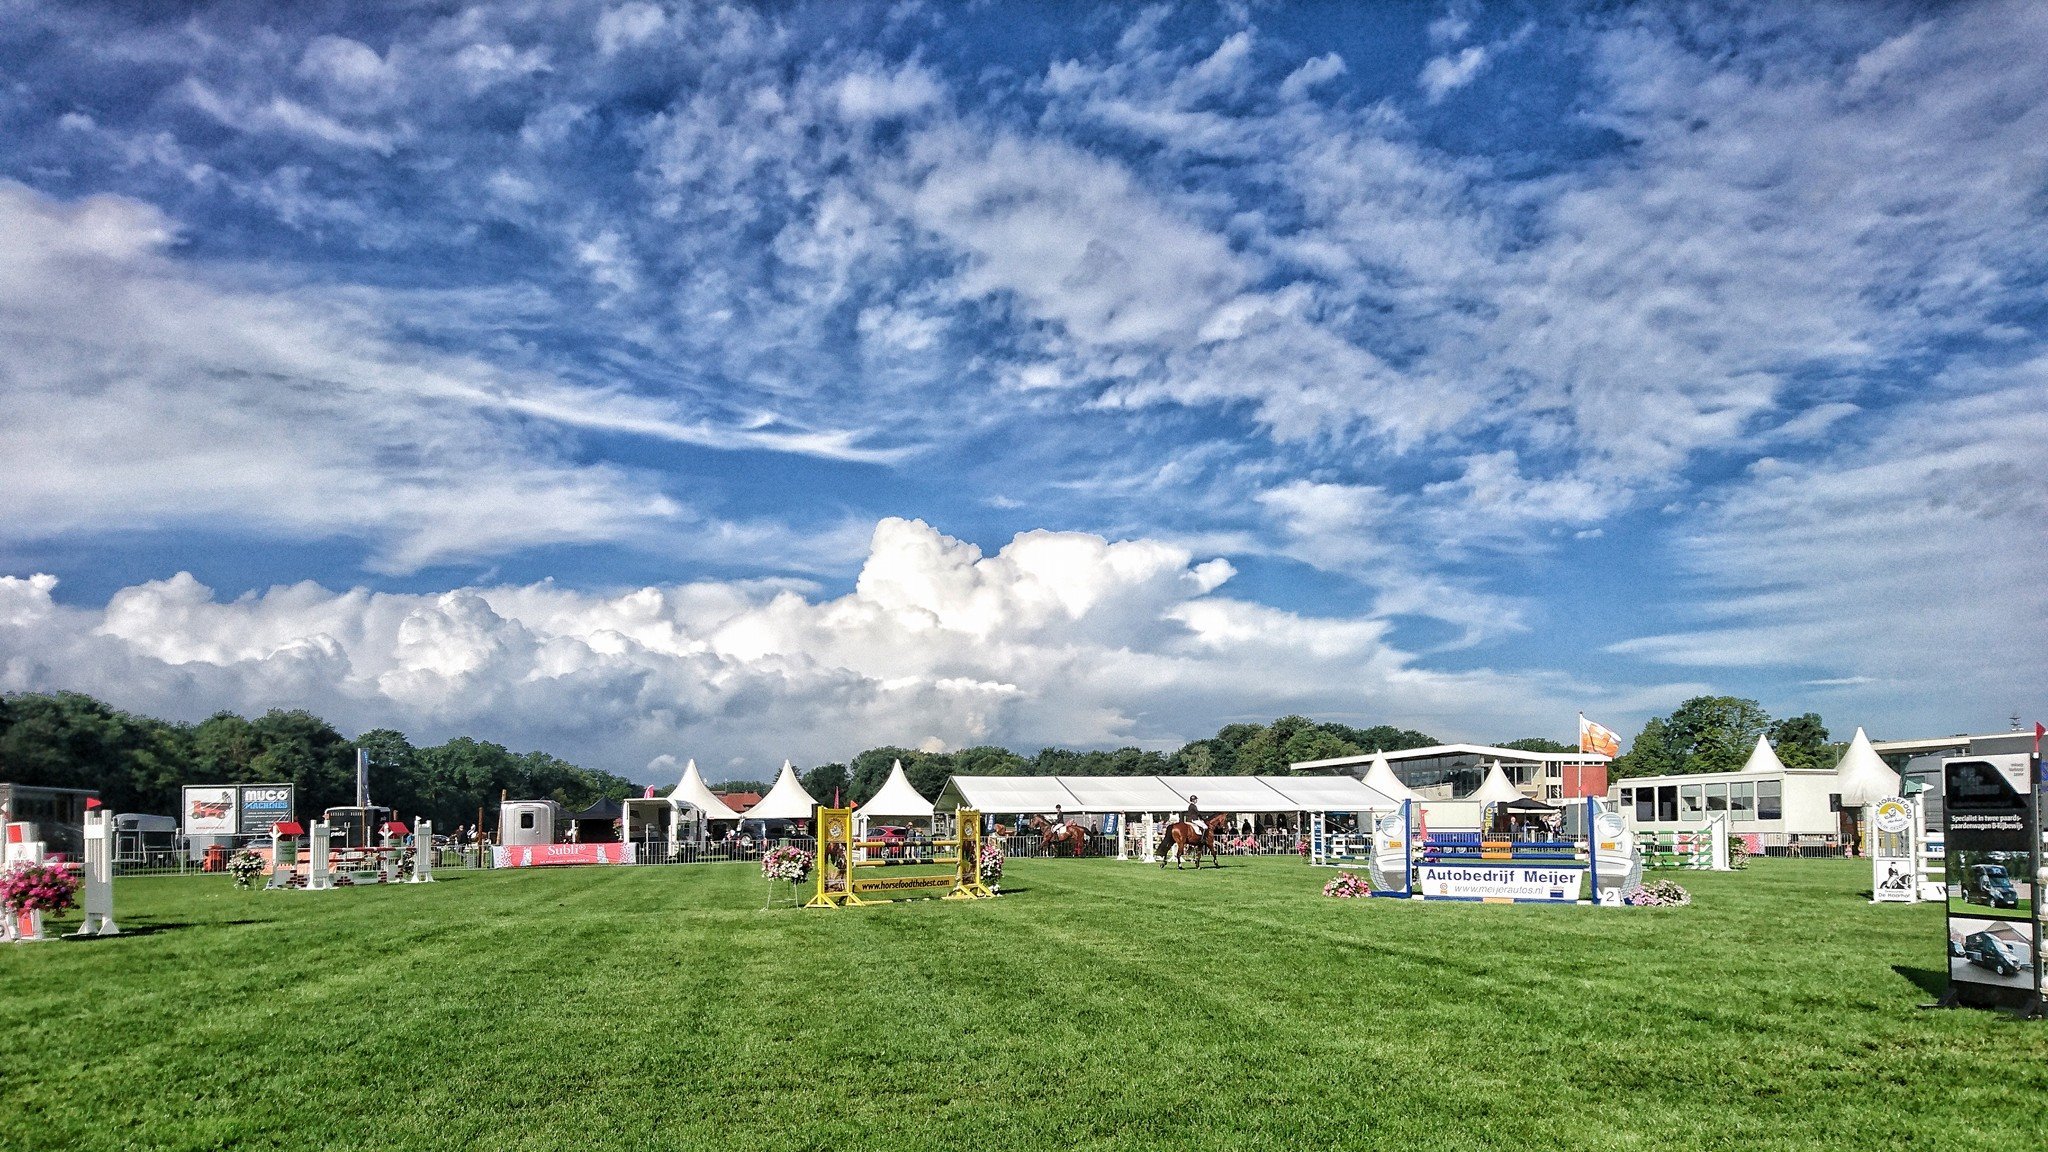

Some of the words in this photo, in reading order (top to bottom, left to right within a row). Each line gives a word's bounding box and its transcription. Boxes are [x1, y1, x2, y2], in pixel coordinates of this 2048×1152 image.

[1876, 797, 1913, 819] HORSEFOOD
[1951, 815, 1978, 823] Specialist
[1950, 822, 1991, 831] paardenwagen
[1426, 868, 1515, 884] Autobedrijf
[1524, 870, 1576, 885] Meijer
[861, 878, 950, 891] www.horsefoodthebest.com
[1454, 884, 1544, 895] www.meijerautos.nl
[1605, 890, 1615, 902] 2
